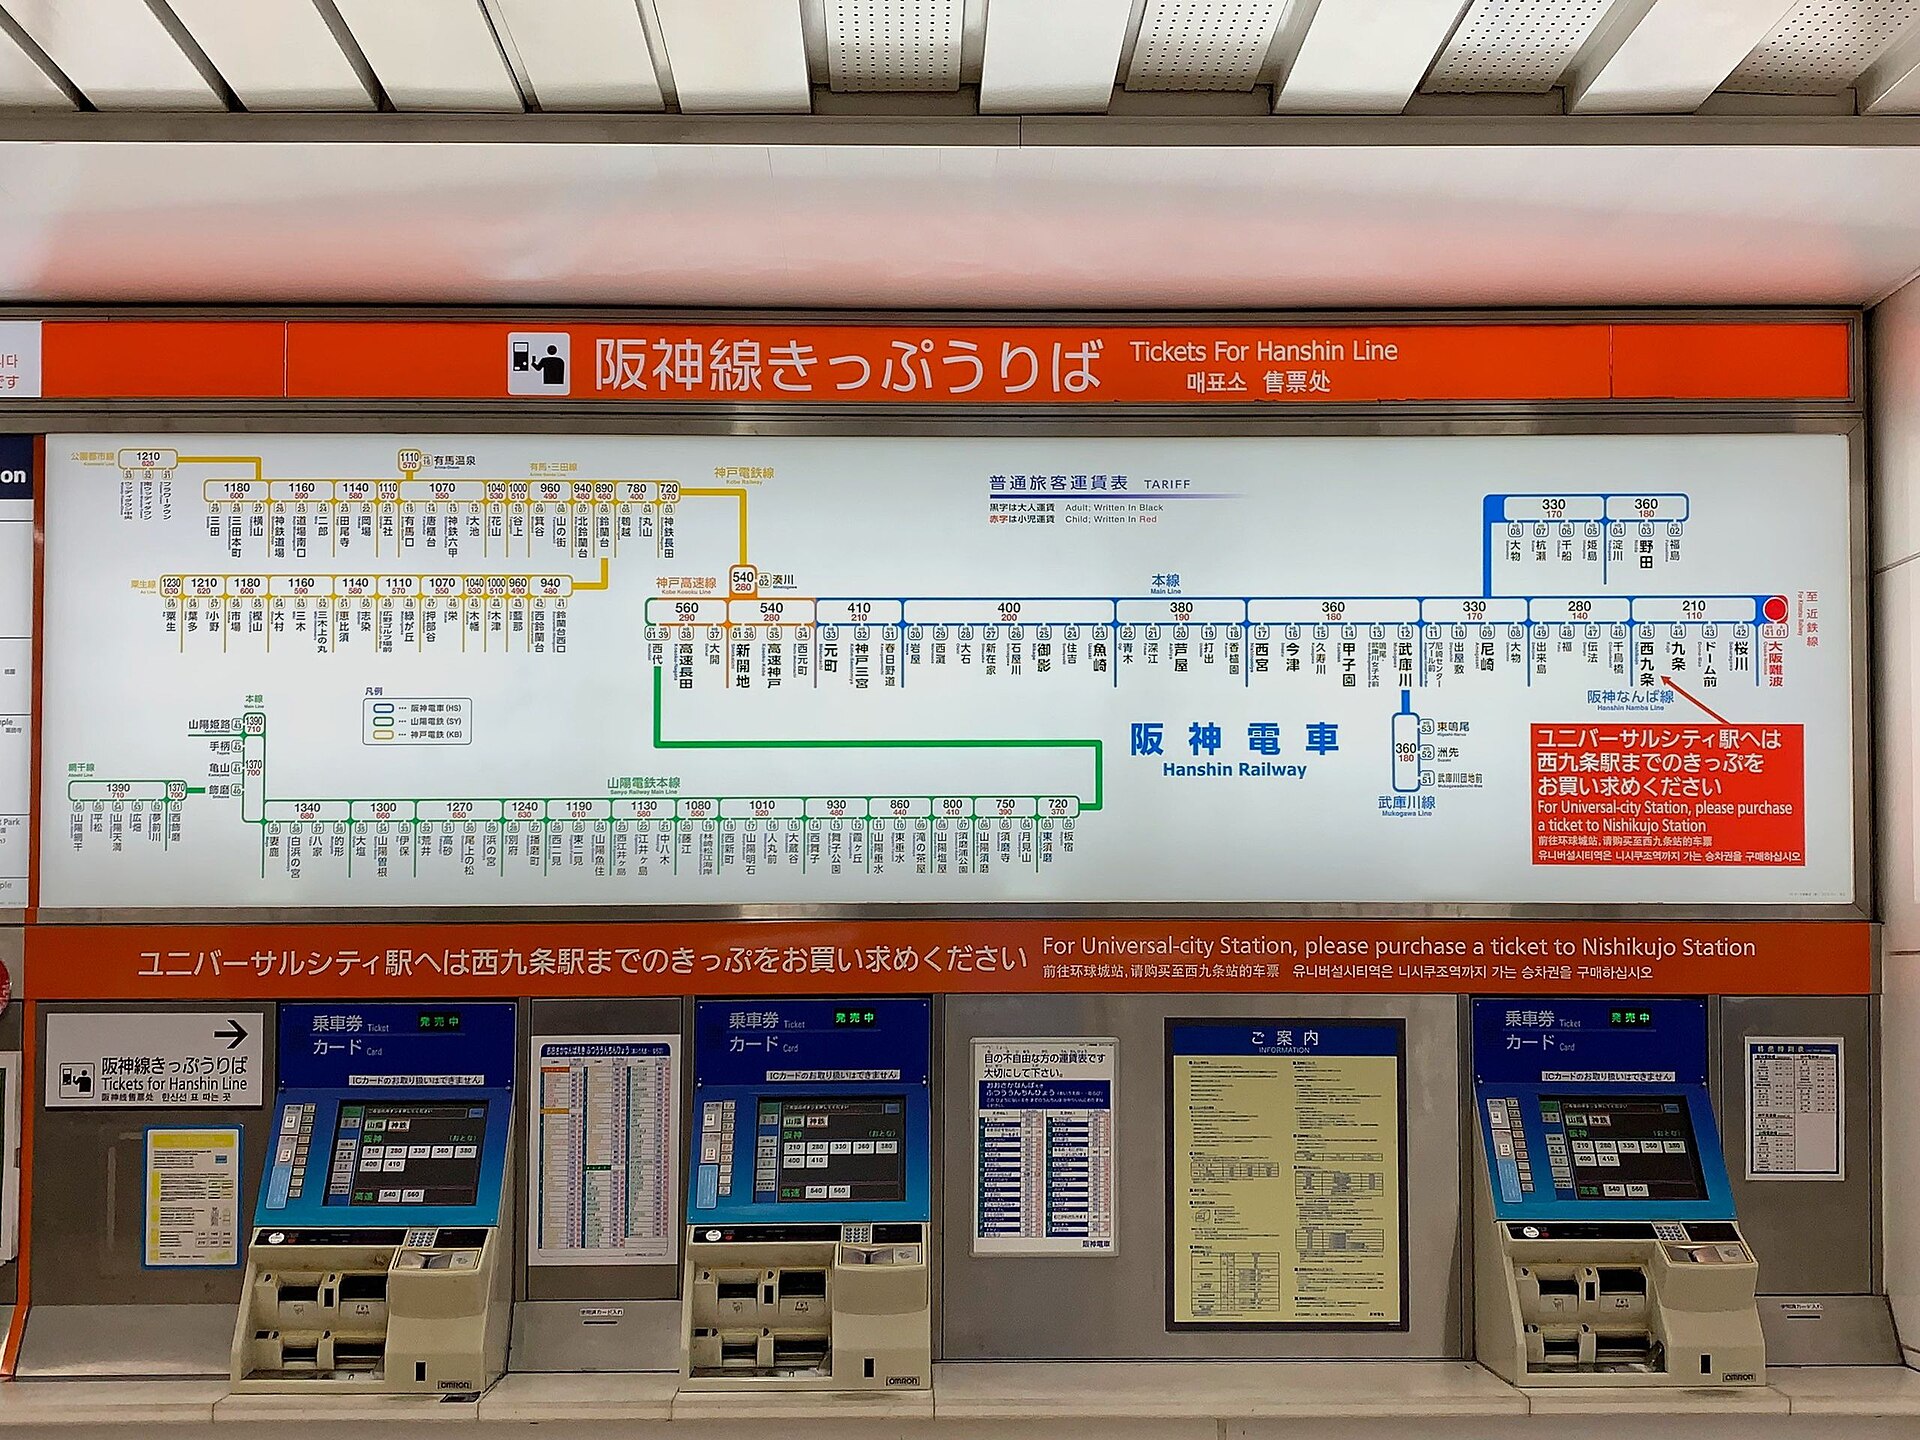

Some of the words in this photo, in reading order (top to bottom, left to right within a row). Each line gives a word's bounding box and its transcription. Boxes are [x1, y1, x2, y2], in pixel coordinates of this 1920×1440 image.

[1130, 341, 1206, 361] Tickets
[1215, 342, 1249, 361] For
[1258, 340, 1344, 361] Hanshin
[1354, 341, 1397, 361] Line
[595, 338, 1103, 394] 阪神線きっぷうりば
[1188, 372, 1247, 393] 매표소
[1263, 370, 1330, 393] 售票处
[434, 456, 475, 465] 有馬温泉
[714, 467, 774, 480] 神戸電鉄線
[225, 483, 250, 492] 1180
[430, 483, 455, 492] 1070
[990, 475, 1127, 490] 普通旅客運賃表
[1144, 480, 1190, 489] TARIFF
[1543, 499, 1565, 509] 330
[1635, 499, 1658, 509] 360
[990, 515, 1054, 523] 赤字は小児運賃
[232, 517, 241, 558] 三田本町
[1640, 540, 1653, 568] 野田
[656, 577, 716, 588] 神戸高速線
[773, 575, 793, 584] 湊川
[1152, 574, 1179, 587] 本線
[676, 603, 698, 613] 560
[760, 603, 783, 613] 540
[848, 603, 870, 613] 410
[998, 603, 1020, 613] 400
[1170, 602, 1193, 612] 380
[1322, 602, 1345, 614] 360
[1463, 601, 1486, 614] 330
[1568, 601, 1591, 614] 280
[1683, 601, 1705, 614] 210
[824, 644, 837, 672] 元町
[1038, 643, 1050, 672] 御影
[1093, 643, 1106, 672] 魚崎
[1175, 643, 1187, 671] 芦屋
[1255, 643, 1268, 671] 西宮
[1287, 643, 1299, 672] 今津
[1343, 643, 1355, 686] 甲子園
[1481, 643, 1494, 671] 尼崎
[1640, 643, 1654, 686] 西九条
[1672, 643, 1685, 671] 九条
[1704, 642, 1717, 687] ドーム前
[1735, 642, 1748, 671] 桜川
[1769, 641, 1783, 686] 大阪難波
[679, 644, 693, 688] 高速長田
[736, 644, 750, 688] 新開地
[768, 643, 781, 688] 高速神戸
[855, 644, 868, 688] 神戸三宮
[1399, 643, 1412, 687] 武庫川
[365, 687, 382, 695] 凡例
[1588, 690, 1674, 703] 阪神なんば線
[189, 720, 230, 731] 山陽姫路
[1538, 729, 1781, 750] ユニバーサルシティ駅へは
[1164, 762, 1232, 776] Hanshin
[1239, 762, 1306, 779] Railway
[1537, 752, 1763, 773] 西九条駅までのきっぷを
[608, 777, 680, 788] 山陽電鉄本線
[1539, 776, 1721, 797] お買い求めください
[749, 799, 775, 810] 1010
[1378, 796, 1435, 809] 武庫川線
[1538, 800, 1558, 813] For
[1562, 800, 1642, 818] Universal-city
[1645, 800, 1692, 815] Station,
[1695, 800, 1734, 817] please
[1737, 801, 1793, 817] purchase
[1537, 822, 1546, 832] a
[1548, 818, 1583, 832] ticket
[1586, 820, 1599, 831] to
[1602, 818, 1660, 836] Nishikujo
[1663, 819, 1707, 833] Station
[1538, 850, 1612, 860] 유니버설시티역은
[1616, 851, 1679, 861] 니시쿠조역까지
[1684, 851, 1702, 862] 가는
[1705, 851, 1742, 862] 승차권을
[1745, 851, 1801, 862] 구매하십시오
[1044, 938, 1075, 954] For
[1083, 936, 1214, 958] Universal-city
[1221, 936, 1297, 956] Station,
[1305, 936, 1368, 958] please
[1376, 936, 1466, 958] purchase
[1474, 942, 1483, 954] a
[1491, 937, 1548, 955] ticket
[1554, 939, 1575, 955] to
[1584, 937, 1675, 960] Nishikujo
[1683, 938, 1755, 957] Station
[139, 945, 1026, 976] ユニバーサルシティ駅へは西九条駅までのきっぷをお買い求めください
[1293, 965, 1393, 978] 유니버설시티역은
[1399, 965, 1487, 978] 니시쿠조역까지
[1492, 966, 1516, 978] 가는
[1522, 966, 1572, 979] 승차권을
[1577, 966, 1653, 979] 구매하십시오
[313, 1015, 362, 1031] 乗車券
[730, 1012, 779, 1029] 乗車券
[784, 1020, 804, 1028] Ticket
[1506, 1011, 1554, 1027] 乗車券
[1559, 1019, 1580, 1027] Ticket
[368, 1024, 388, 1032] Ticket
[314, 1039, 361, 1055] カード
[730, 1036, 778, 1052] カード
[783, 1044, 798, 1052] Card
[1507, 1034, 1554, 1050] カード
[1560, 1043, 1575, 1051] Card
[101, 1056, 248, 1076] 阪神線きっぷうりば
[984, 1053, 1105, 1065] 目の不自由な方の運賃表です
[984, 1068, 1062, 1079] 大切にして下さい。
[101, 1077, 143, 1090] Tickets
[147, 1077, 165, 1090] for
[169, 1076, 219, 1091] Hanshin
[223, 1076, 248, 1091] Line
